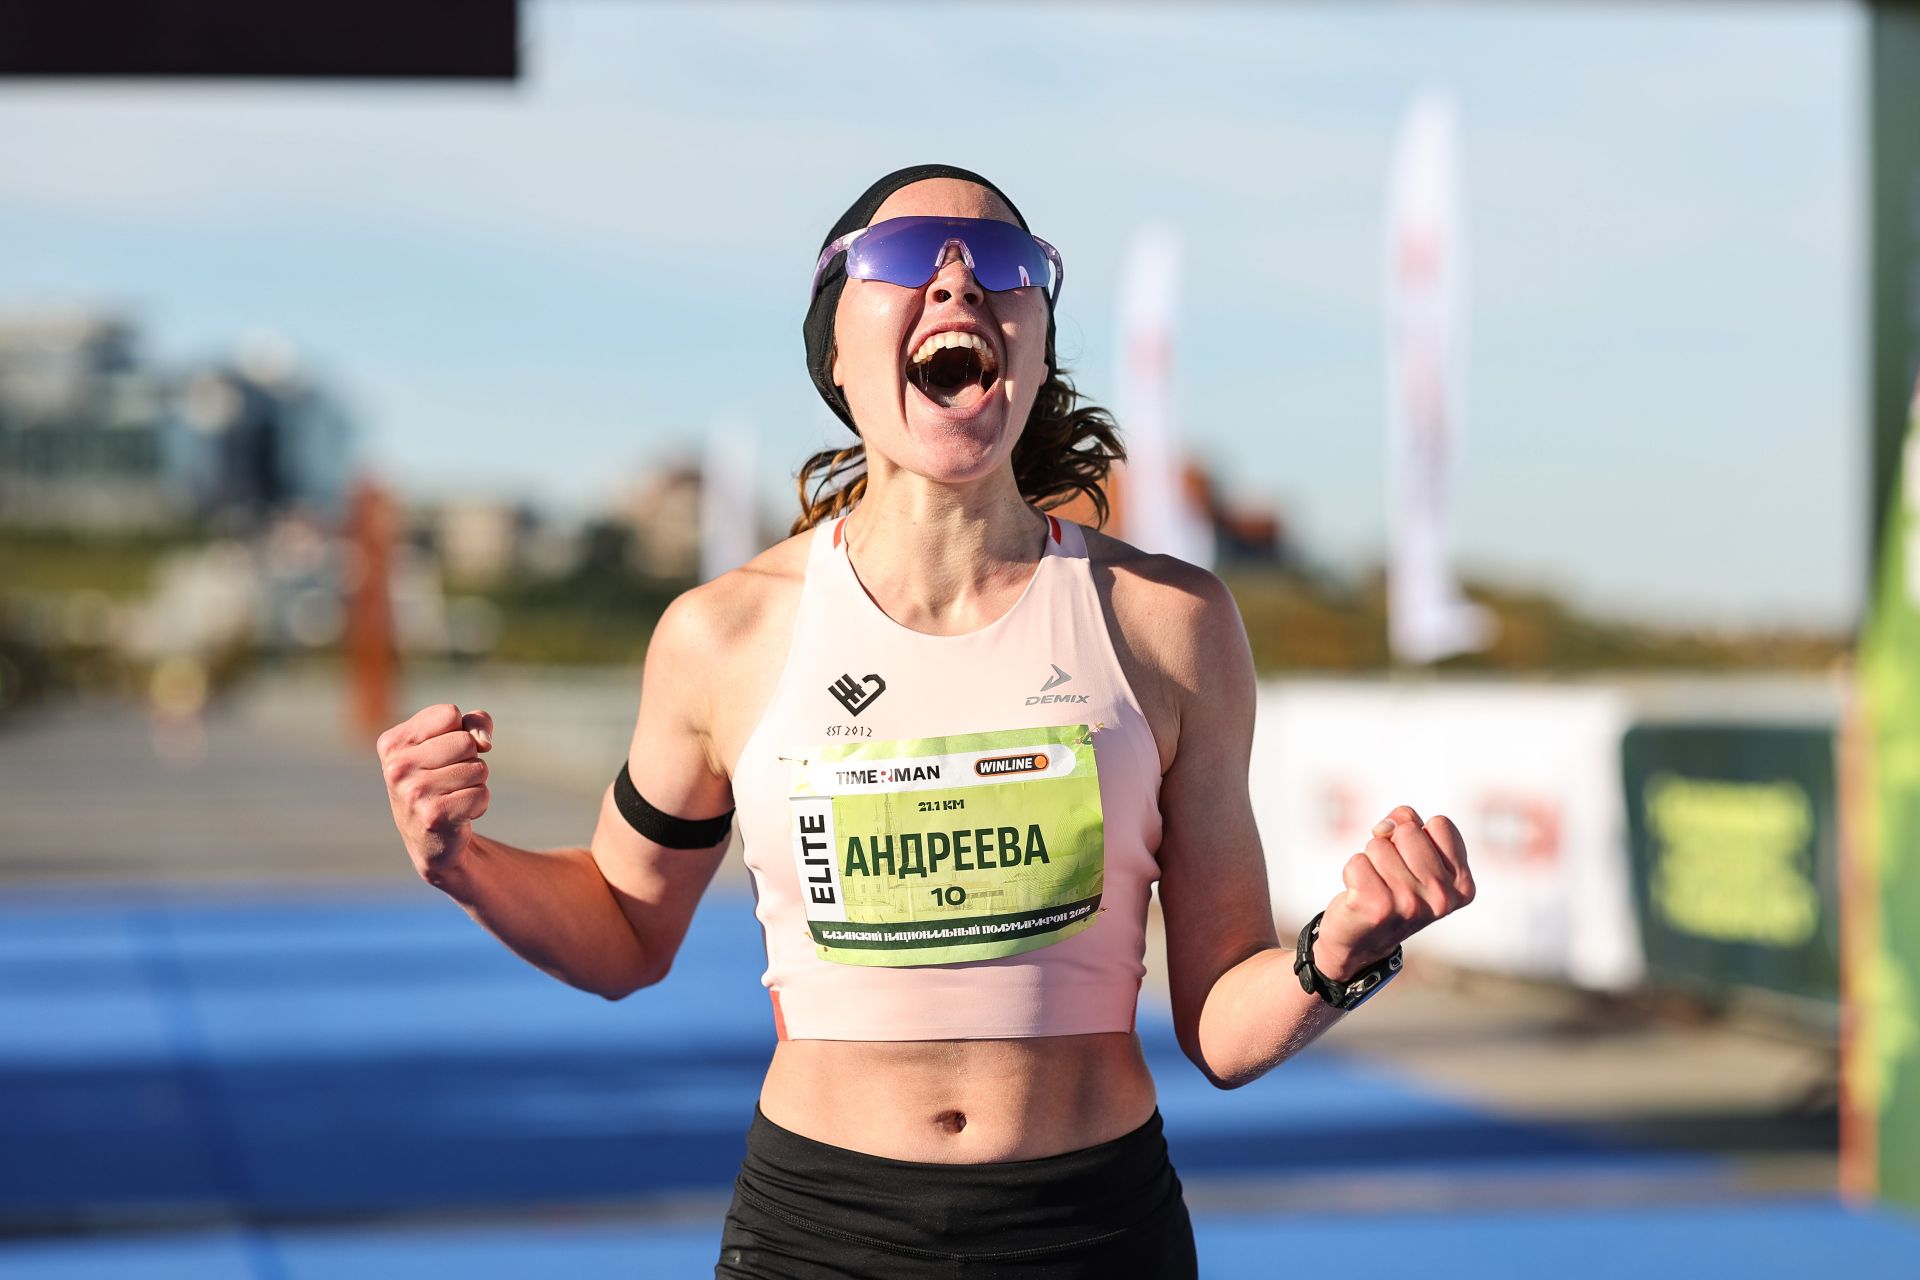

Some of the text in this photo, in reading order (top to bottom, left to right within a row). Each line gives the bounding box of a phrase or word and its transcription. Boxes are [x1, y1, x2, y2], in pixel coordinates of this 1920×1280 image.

[1025, 695, 1090, 706] DEMIX
[826, 725, 873, 737] EST 2012
[980, 757, 1033, 774] WINLINE
[918, 801, 940, 812] 21.1
[800, 814, 836, 904] ELITE
[845, 824, 1050, 879] АНДРЕЕВА
[931, 886, 967, 907] 10
[822, 930, 883, 941] КАЗАНСКИЙ
[884, 925, 980, 942] НАЦИОНАЛЬНЫЙ
[982, 912, 1068, 935] ПОЛУМАРАФОН
